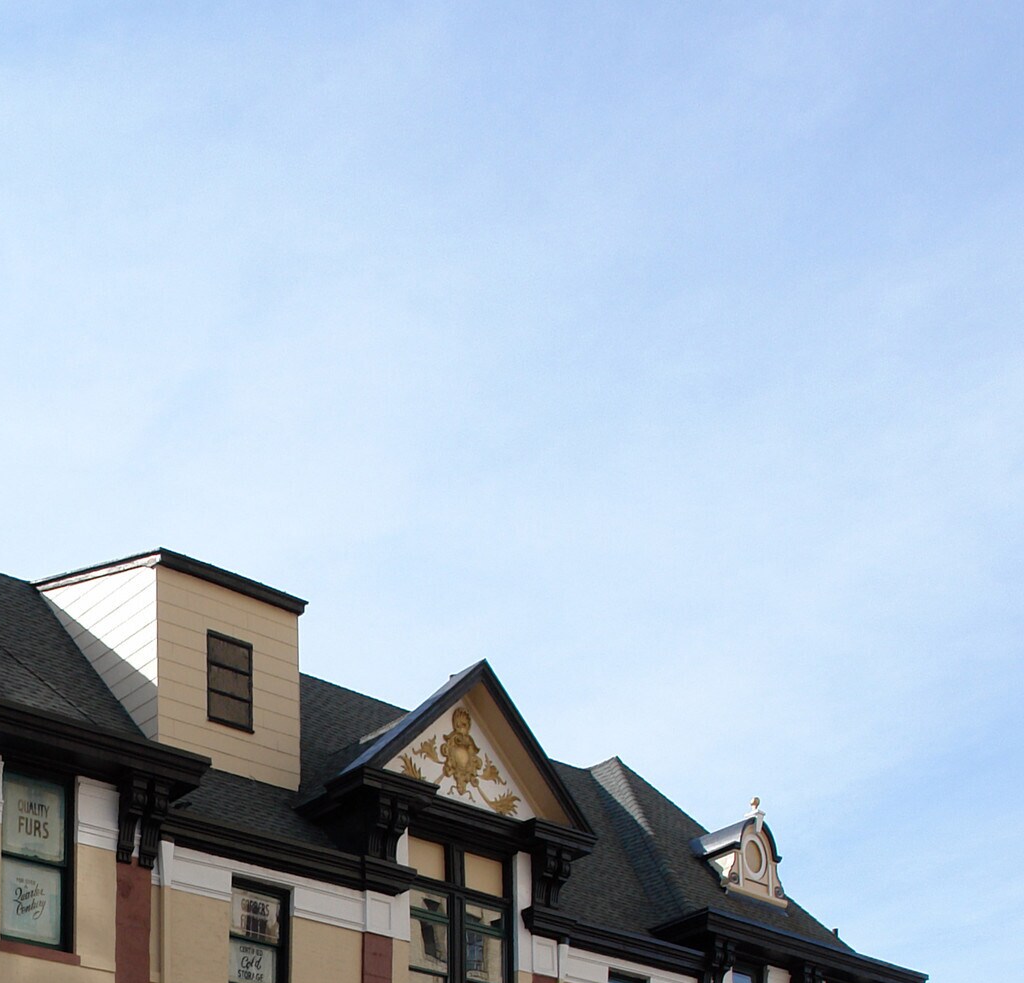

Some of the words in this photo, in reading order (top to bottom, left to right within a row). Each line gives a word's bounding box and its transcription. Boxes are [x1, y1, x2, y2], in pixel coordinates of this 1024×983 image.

[18, 799, 50, 819] QUALITY
[18, 815, 49, 839] FURS
[241, 956, 262, 970] Cold
